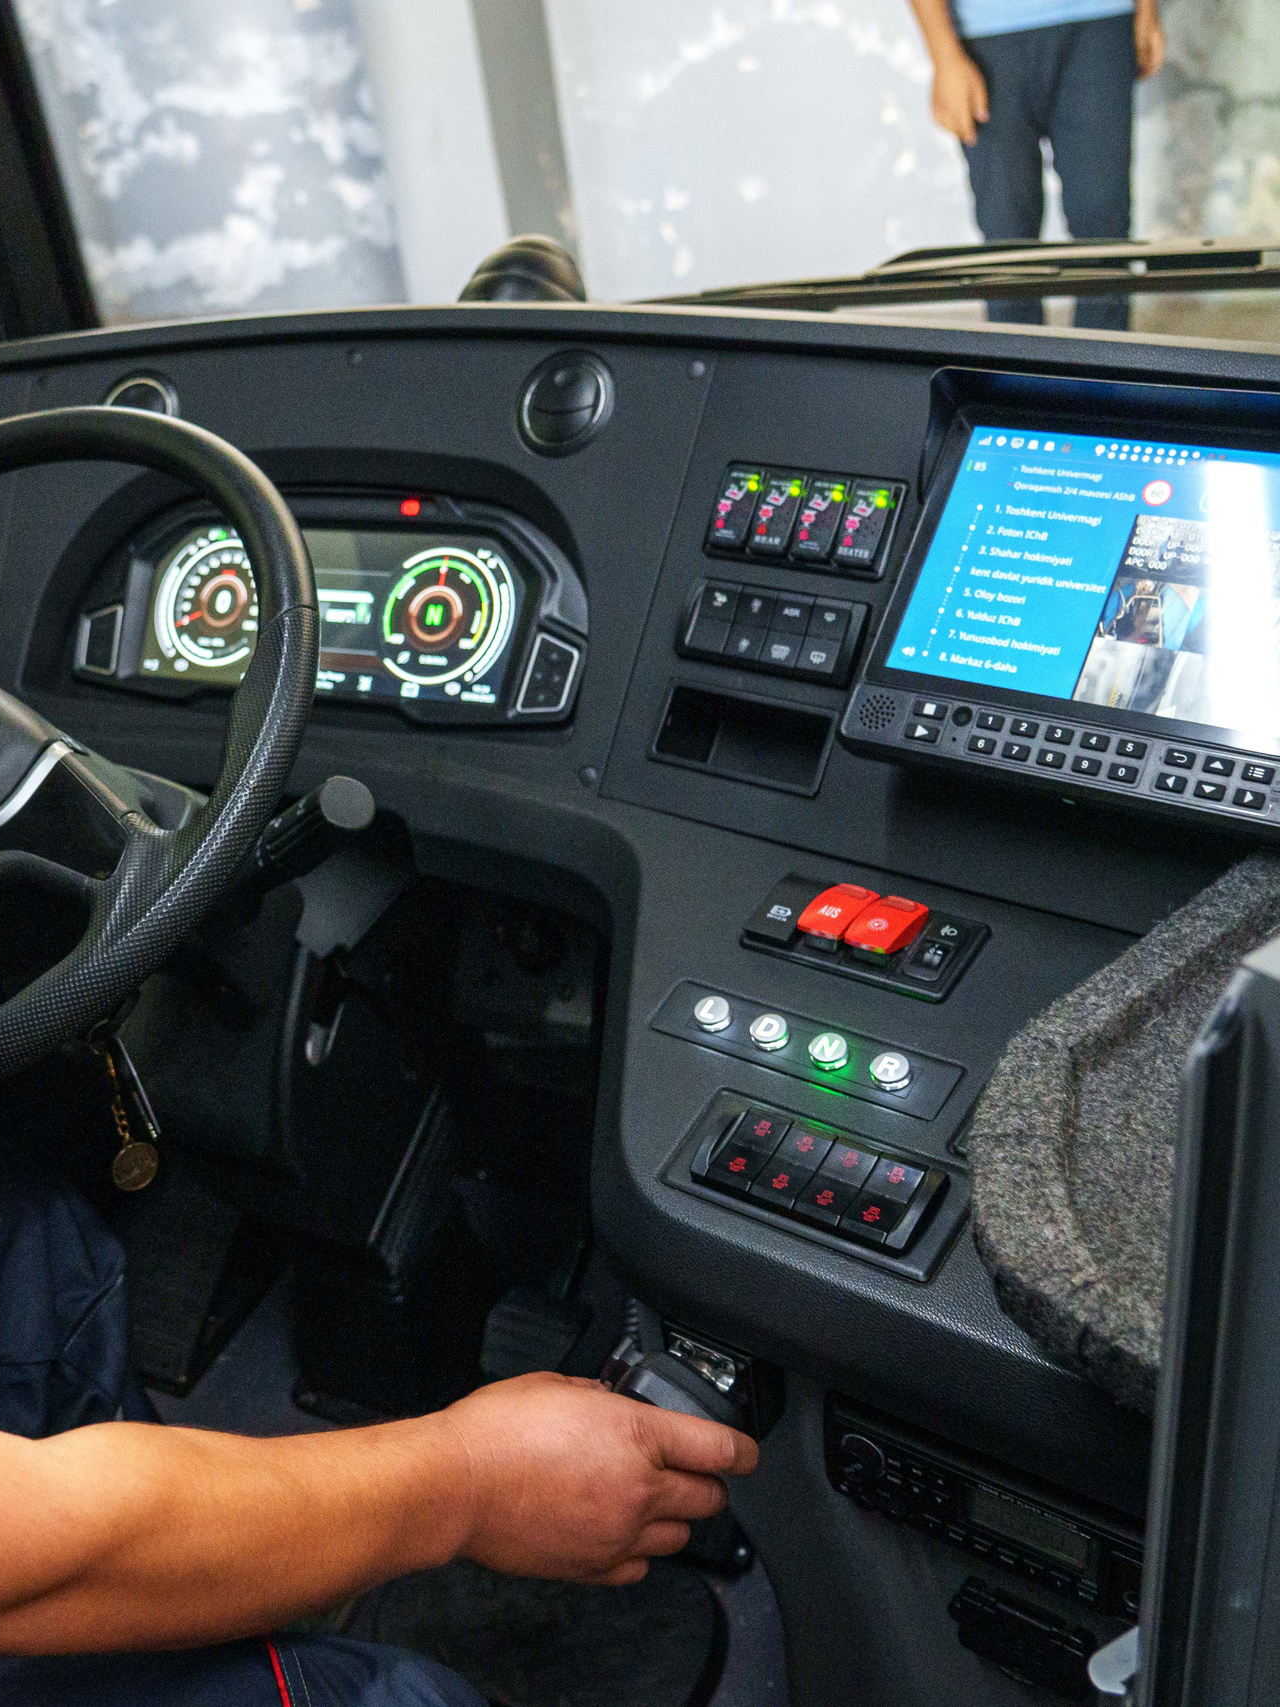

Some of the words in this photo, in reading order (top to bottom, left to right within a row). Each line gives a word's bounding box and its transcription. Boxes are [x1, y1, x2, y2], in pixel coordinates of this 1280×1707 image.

[1021, 465, 1056, 478] Toshkent
[1057, 468, 1103, 483] Univermagi
[1014, 481, 1063, 496] Qoraqamish
[1063, 486, 1078, 496] 2/4
[1149, 488, 1165, 499] 60
[1006, 505, 1047, 519] Toshkent
[1048, 510, 1102, 527] Univermagi
[997, 526, 1024, 539] Foton
[989, 546, 1023, 560] Shahar
[1023, 550, 1073, 567] hokimiyati
[970, 566, 991, 578] kent
[992, 570, 1021, 583] davlat
[1021, 574, 1054, 587] yuridik
[1055, 578, 1107, 594] universitet
[974, 589, 997, 602] Oloy
[997, 592, 1026, 605] bozori
[425, 603, 444, 626] N
[967, 610, 997, 623] Yulduz
[959, 631, 1010, 648] Yunusobod
[1011, 639, 1061, 656] hokimiyati
[950, 653, 983, 668] Markaz
[984, 660, 1017, 674] 6-daha
[987, 716, 993, 726] 1
[1019, 722, 1028, 733] 2
[1053, 728, 1062, 739] 3
[977, 739, 985, 749] 6
[1089, 735, 1098, 746] 4
[1011, 745, 1020, 755] 7
[1125, 742, 1134, 753] 5
[1045, 752, 1053, 763] 8
[1080, 759, 1089, 770] 9
[1117, 767, 1125, 777] 0
[818, 905, 841, 918] AUS
[699, 999, 715, 1019] L
[756, 1017, 779, 1037] D
[814, 1036, 841, 1058] N
[877, 1056, 901, 1075] R
